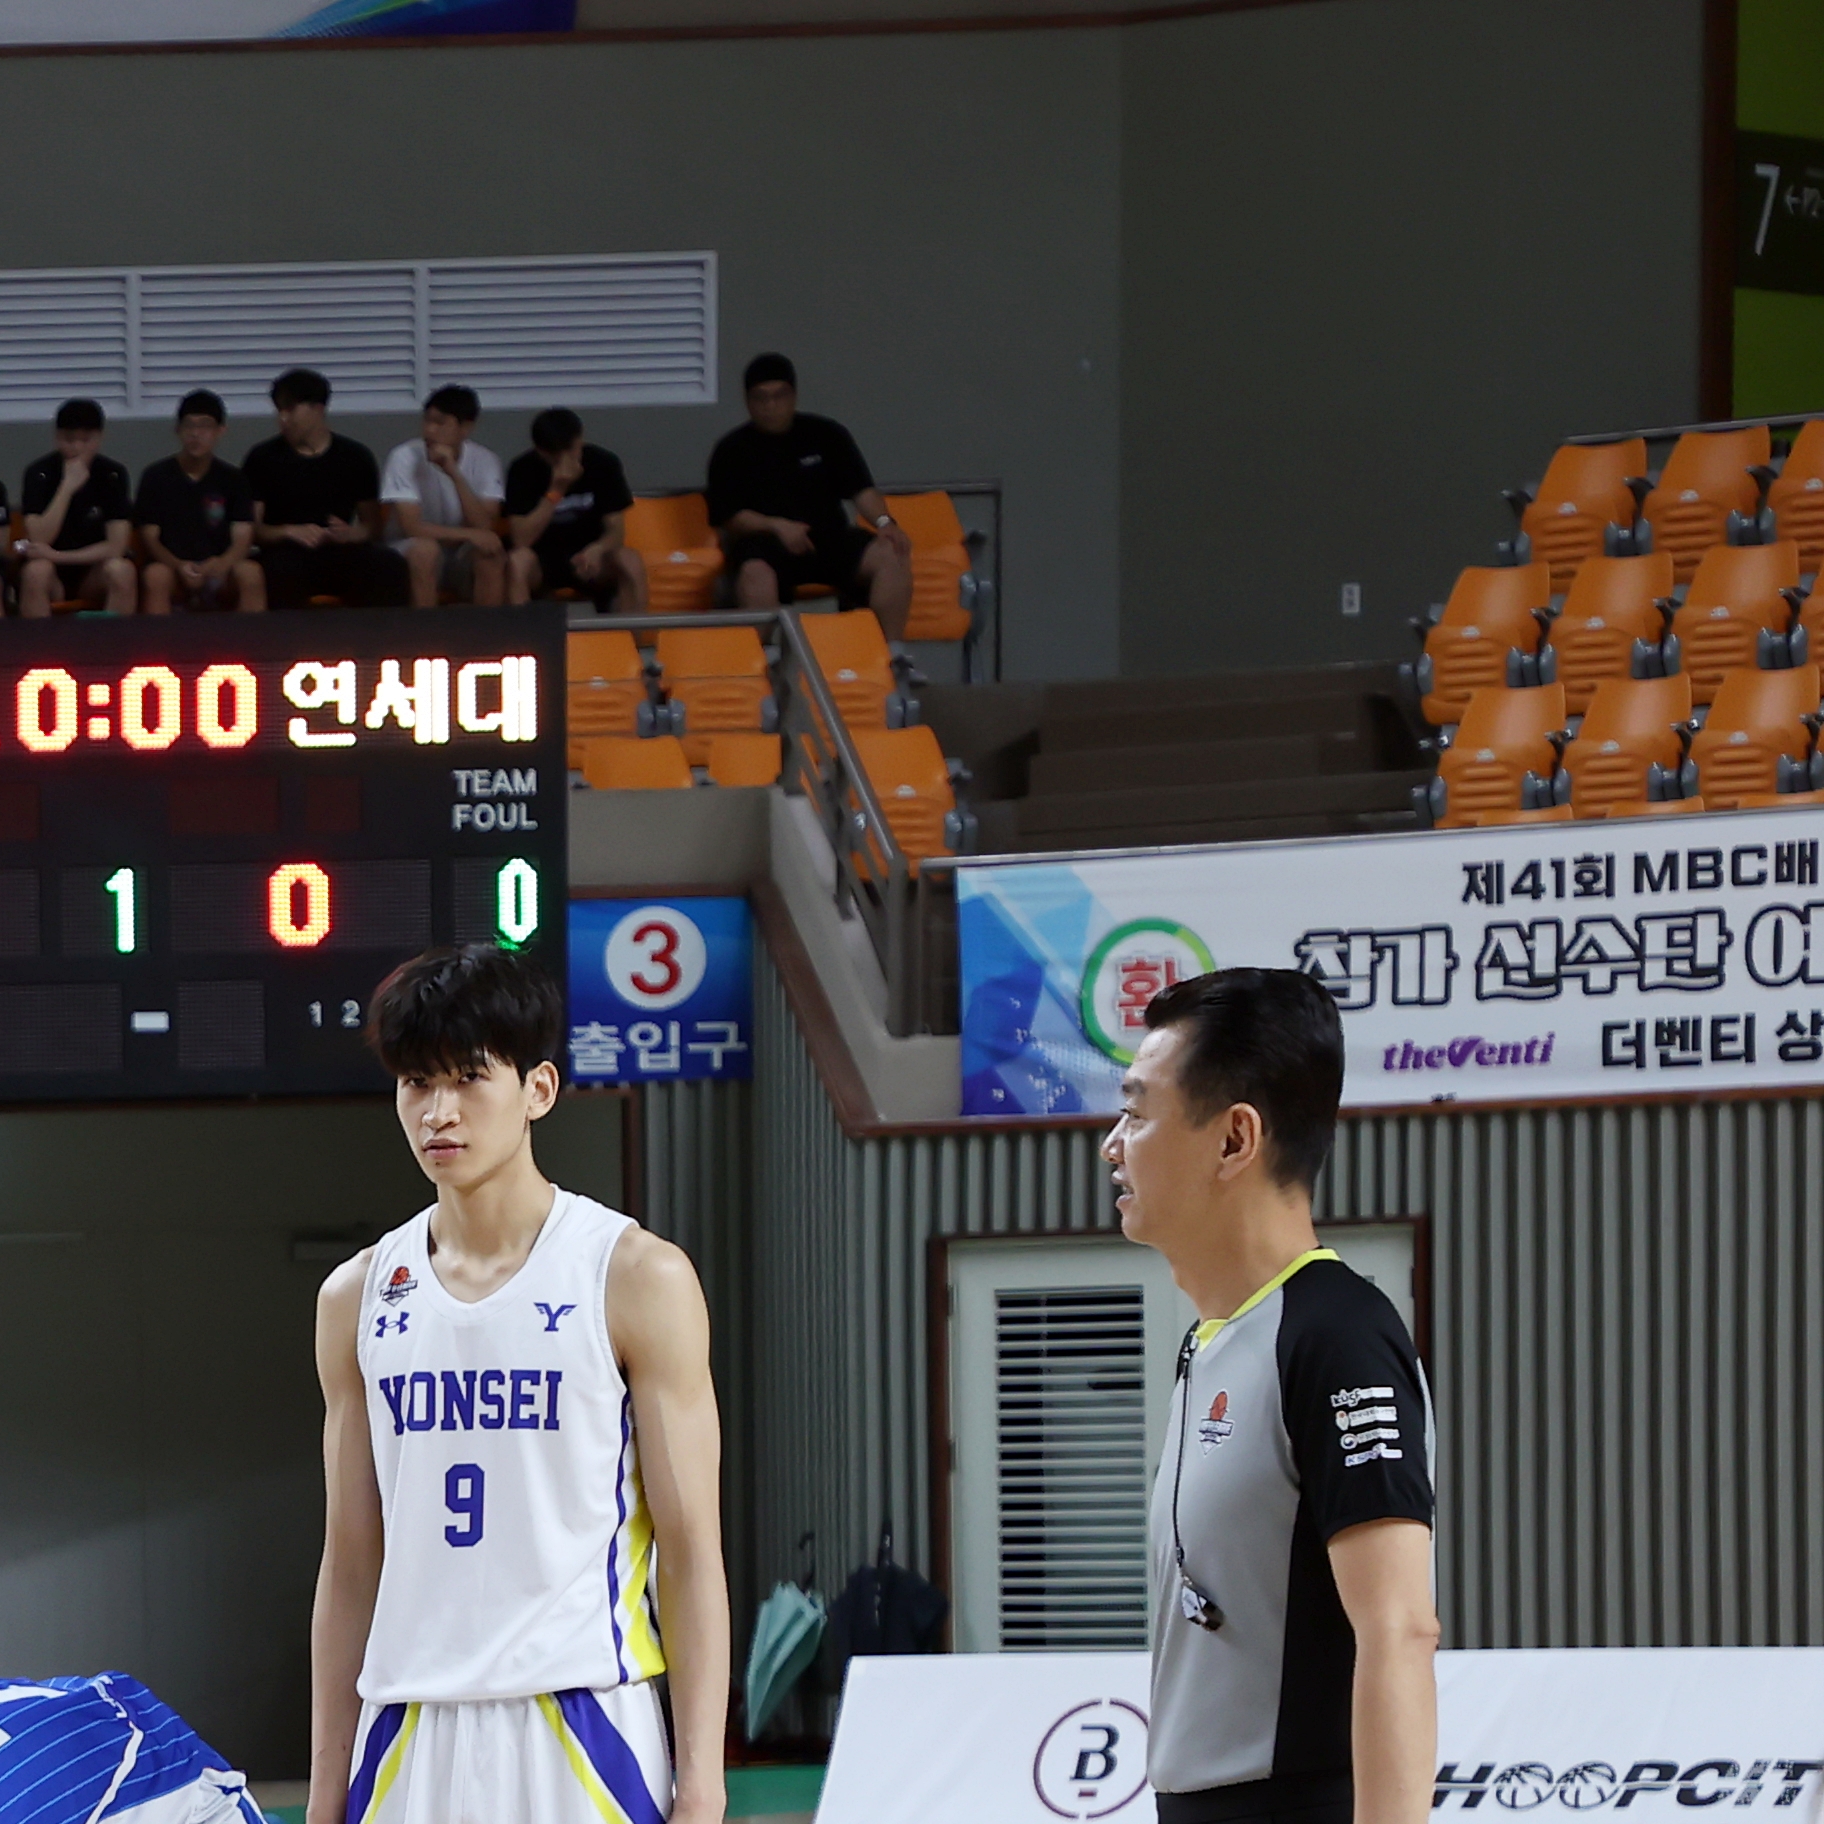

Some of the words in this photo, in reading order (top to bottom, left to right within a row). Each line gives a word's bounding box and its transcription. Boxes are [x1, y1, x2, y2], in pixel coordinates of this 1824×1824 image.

[1755, 163, 1780, 256] 7
[283, 656, 538, 748] 연세대
[452, 769, 538, 797] TEAM
[452, 803, 538, 832] FOUL
[1462, 852, 1616, 905] 제41회
[1633, 838, 1819, 896] MBC배
[104, 867, 136, 953] 1
[268, 863, 330, 947] 0
[498, 858, 538, 943] 0
[630, 919, 683, 997] 3
[1475, 906, 1735, 1002] 선수단
[309, 1000, 324, 1028] 1
[341, 999, 361, 1029] 2
[1601, 1013, 1756, 1070] 더벤티
[568, 1020, 749, 1077] 출입구
[379, 1369, 563, 1437] YONSEI
[444, 1463, 485, 1548] 9
[1069, 1723, 1121, 1782] B
